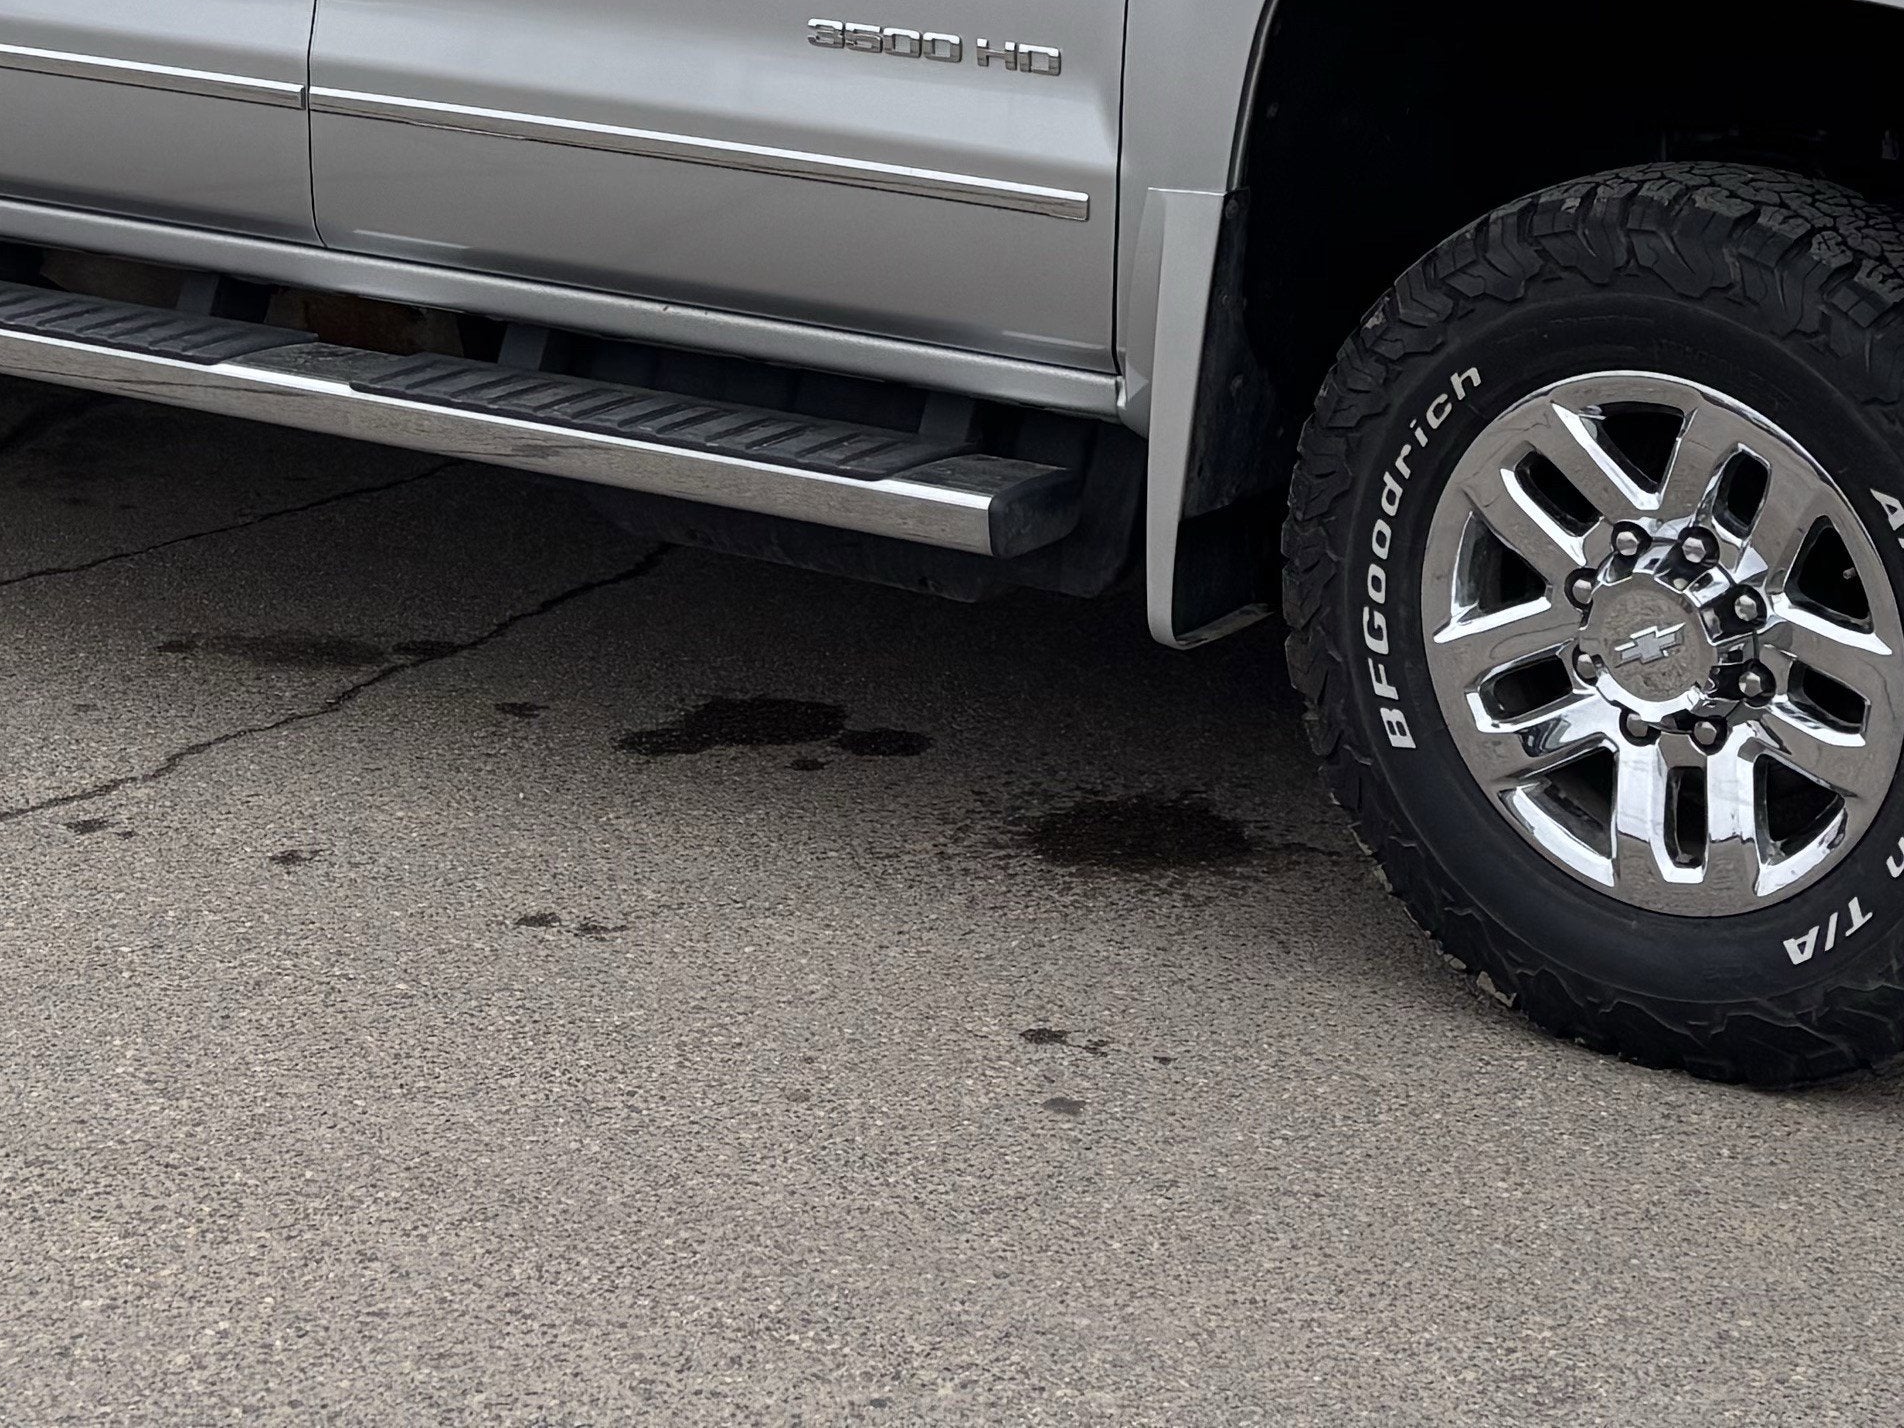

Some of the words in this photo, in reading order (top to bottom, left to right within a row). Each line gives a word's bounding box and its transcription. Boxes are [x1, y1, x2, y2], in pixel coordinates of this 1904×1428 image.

[807, 18, 963, 63] 3500
[976, 38, 1062, 76] HD
[1363, 366, 1482, 749] BFGoodrich
[1782, 895, 1874, 966] T/A
